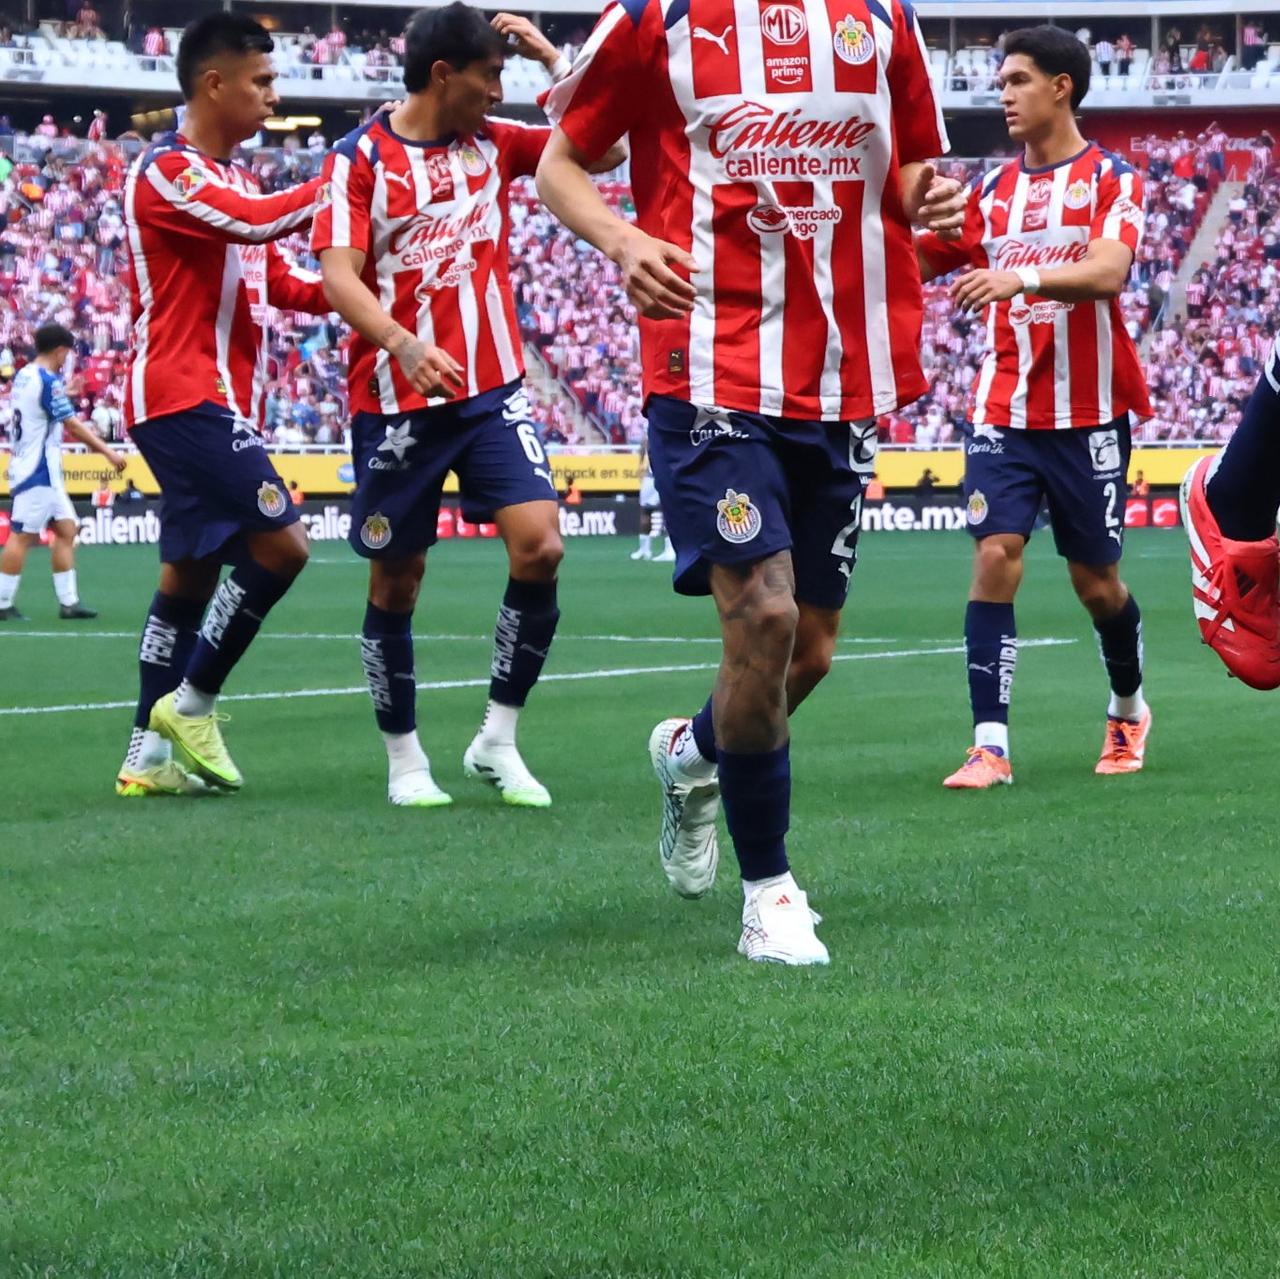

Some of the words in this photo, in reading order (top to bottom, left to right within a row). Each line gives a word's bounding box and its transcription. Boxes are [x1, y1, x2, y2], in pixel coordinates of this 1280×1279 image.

[767, 10, 801, 40] MG
[766, 56, 808, 68] amazon
[771, 65, 804, 78] prime
[704, 101, 876, 159] Caliente
[725, 154, 861, 177] caliente.mx
[516, 423, 544, 464] 6
[62, 467, 123, 480] mercados
[1103, 482, 1120, 528] 2
[831, 493, 862, 559] 2
[201, 578, 246, 650] PERDURA
